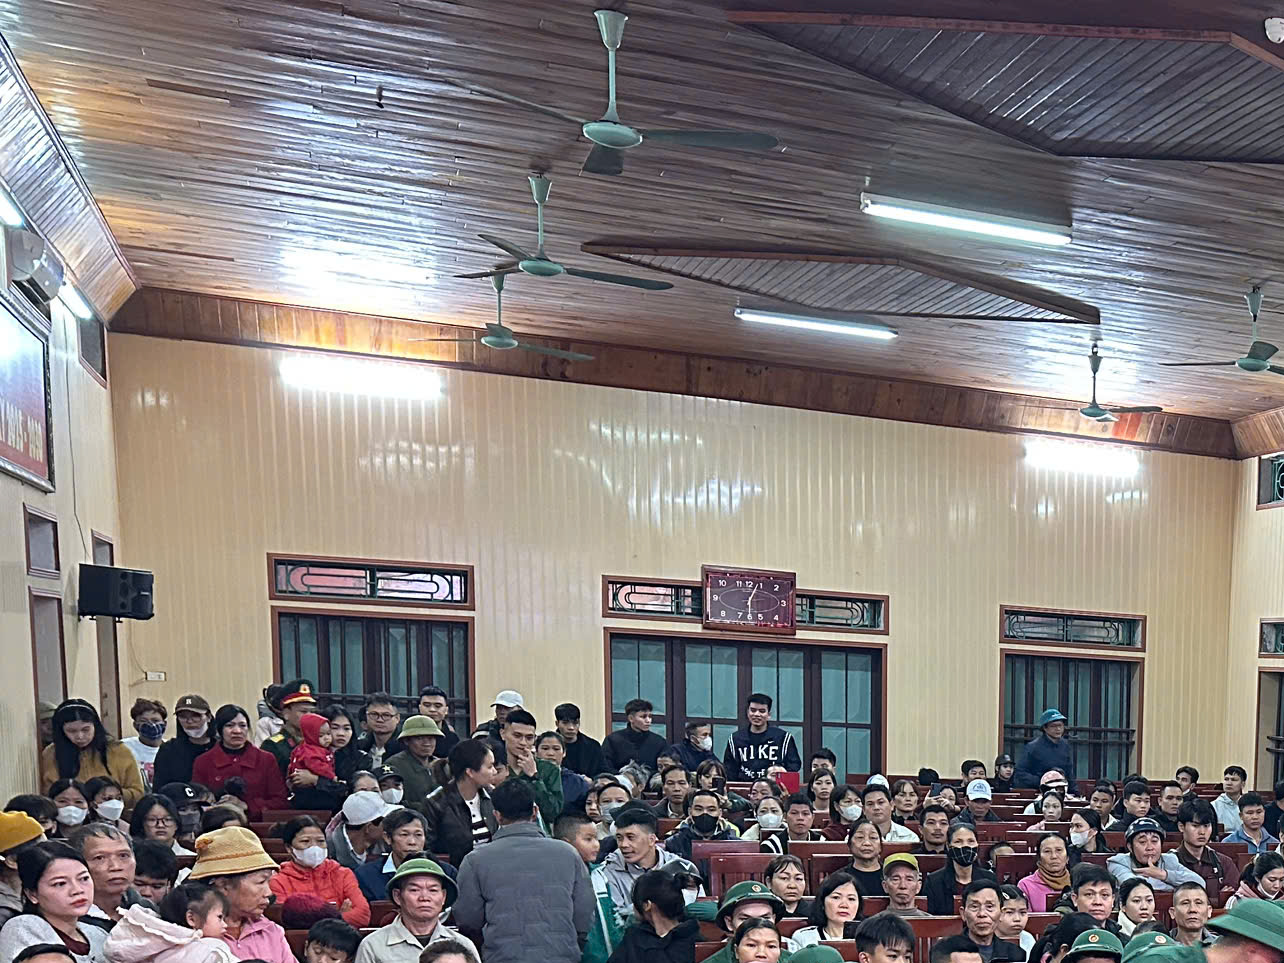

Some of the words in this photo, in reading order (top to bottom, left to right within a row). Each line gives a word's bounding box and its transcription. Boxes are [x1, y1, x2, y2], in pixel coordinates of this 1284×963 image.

[718, 579, 727, 587] 10
[745, 580, 754, 588] 12
[773, 584, 780, 592] 2
[737, 611, 743, 619] 7
[757, 613, 764, 621] 5
[738, 744, 779, 762] NIKE
[185, 787, 194, 797] C
